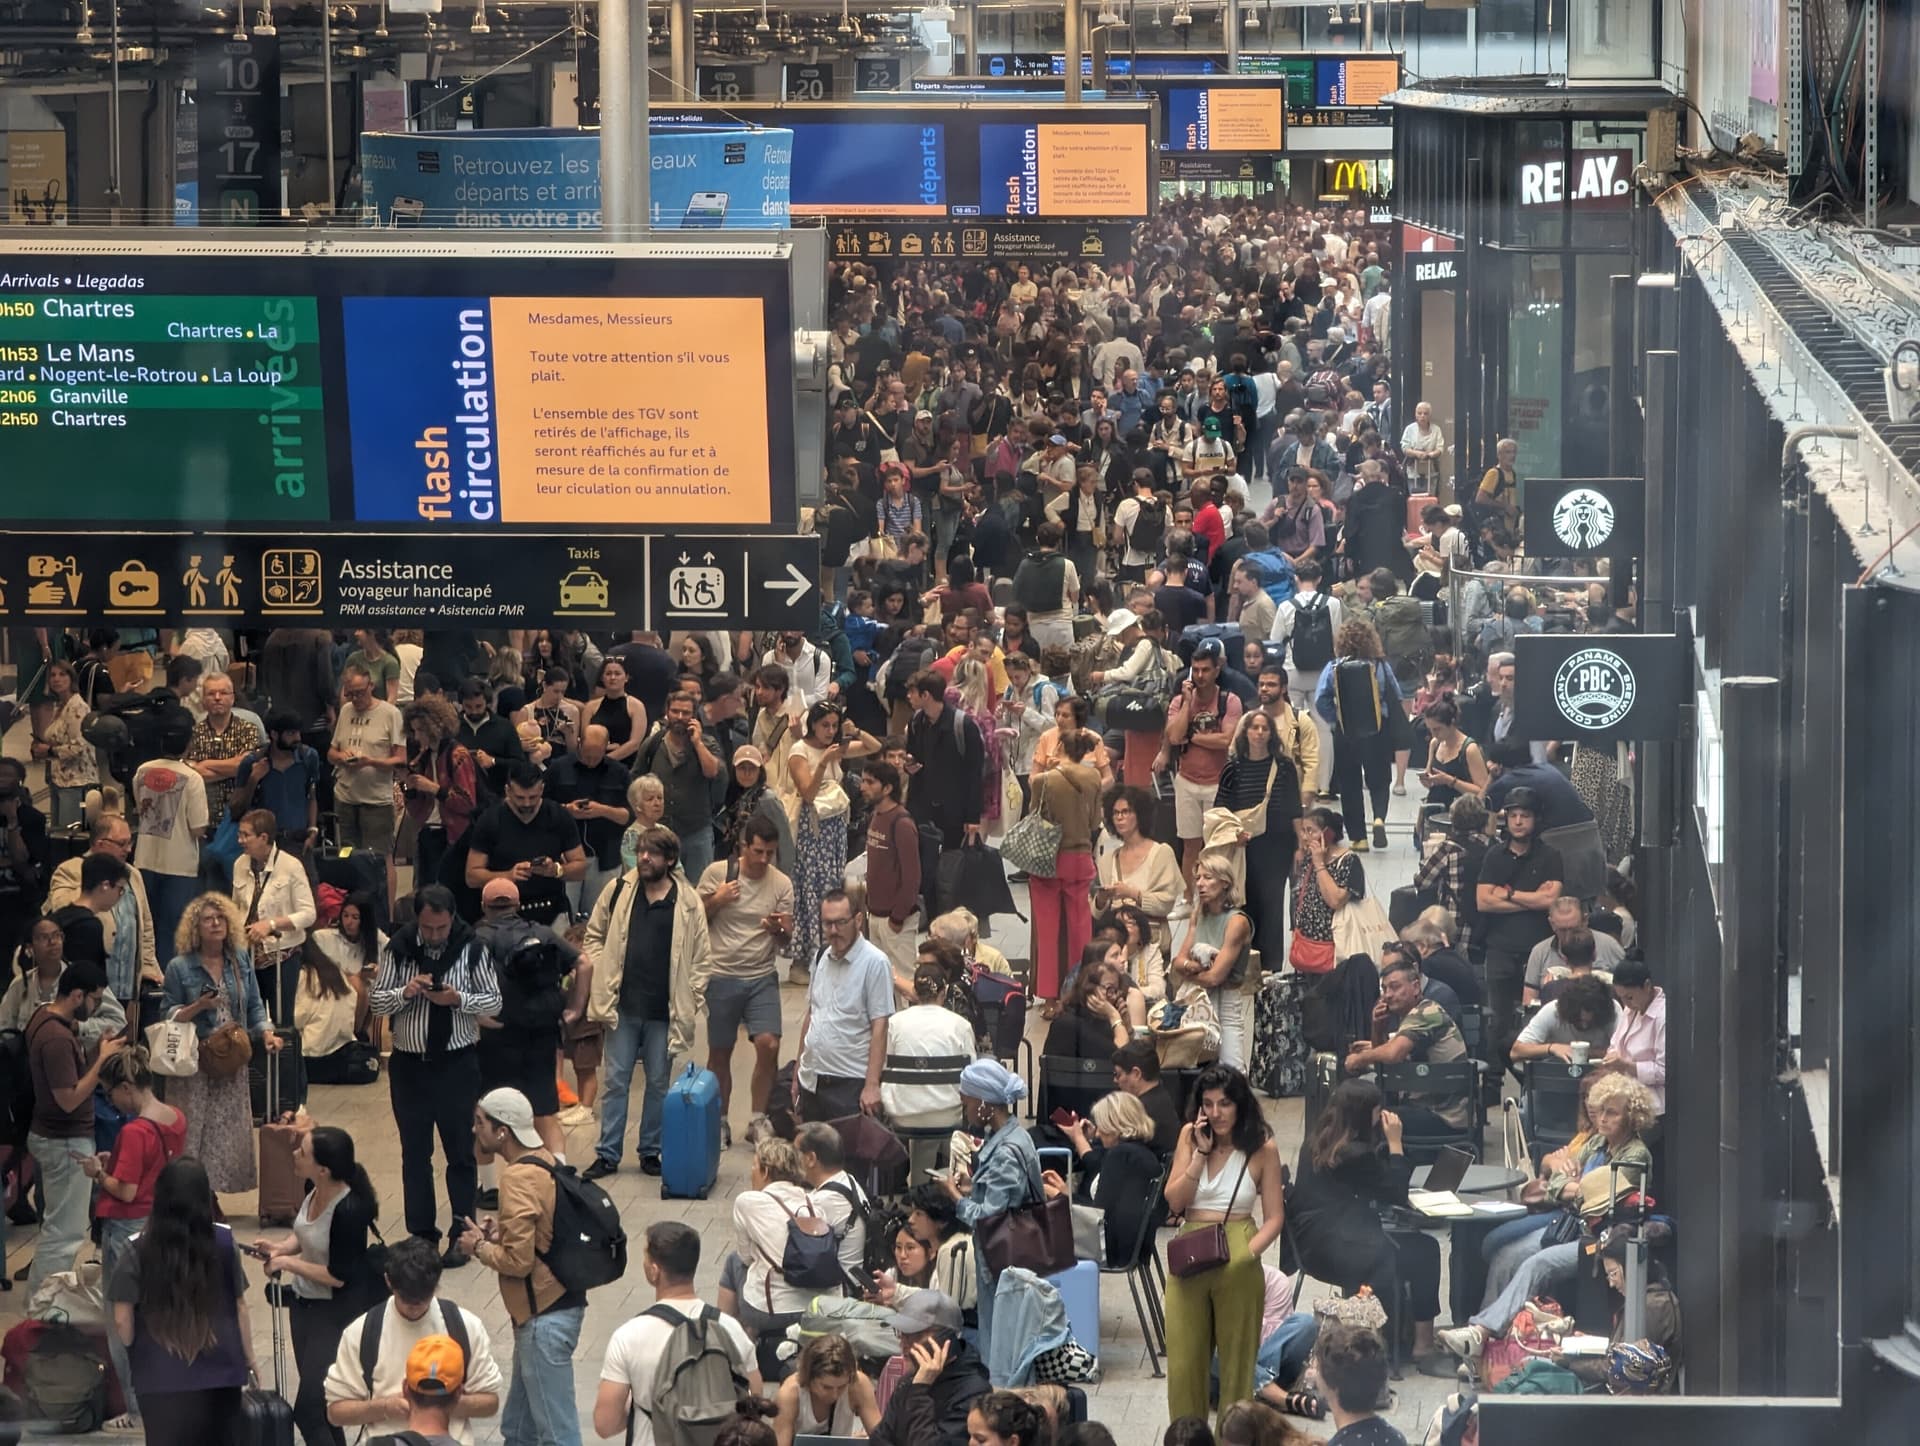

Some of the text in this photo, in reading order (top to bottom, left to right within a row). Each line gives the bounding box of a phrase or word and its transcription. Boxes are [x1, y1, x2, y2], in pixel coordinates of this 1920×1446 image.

[218, 58, 260, 90] 10
[867, 71, 890, 88] 22
[1337, 62, 1346, 105] circulation
[710, 83, 740, 101] 18
[797, 79, 824, 100] 20
[1329, 85, 1338, 105] flash
[1197, 91, 1208, 150] circulation
[1186, 123, 1197, 150] flash
[218, 141, 261, 173] 17
[454, 155, 553, 175] Retrouvez
[560, 153, 589, 174] les
[920, 127, 941, 205] départs
[1022, 128, 1037, 215] circulation
[455, 181, 529, 206] départs
[536, 182, 555, 201] et
[1006, 176, 1020, 216] flash
[230, 198, 249, 219] N
[455, 205, 501, 226] dans
[508, 208, 569, 226] votre
[762, 196, 784, 216] dans
[993, 233, 1041, 242] Assistance
[1416, 261, 1454, 282] RELAY
[0, 273, 145, 291] Arrivals Llegadas
[43, 298, 135, 318] Chartres
[528, 312, 673, 327] Mesdames, Messieurs
[167, 322, 278, 339] Chartres La
[47, 343, 72, 362] Le
[78, 343, 135, 362] Mans
[531, 351, 730, 364] Toute votre attention s'il vous
[40, 366, 197, 386] Nogent-le-Rotrou
[213, 367, 233, 383] La
[238, 367, 282, 387] Loup
[531, 369, 566, 383] plait.
[50, 388, 129, 404] Granville
[255, 299, 306, 499] arrivées
[51, 410, 127, 426] Chartres
[451, 308, 494, 521] circulation
[533, 408, 699, 420] L'ensemble des TGV sont
[534, 426, 690, 442] retirés de l'affichage, ils
[535, 445, 717, 458] seront réaffichés au fur et à
[415, 426, 452, 521] flash
[536, 463, 730, 477] mesure de la confirmation de
[537, 482, 731, 495] leur ciculation ou annulation.
[567, 547, 601, 559] Taxis
[339, 559, 453, 580] Assistance
[339, 584, 492, 601] voyageur handicapé
[339, 604, 525, 616] PRM assistance Asistencia PMR
[1569, 652, 1621, 669] PANAME
[1580, 665, 1611, 692] PBC
[1558, 675, 1592, 725] COMPANY
[1601, 674, 1633, 725] BREWING
